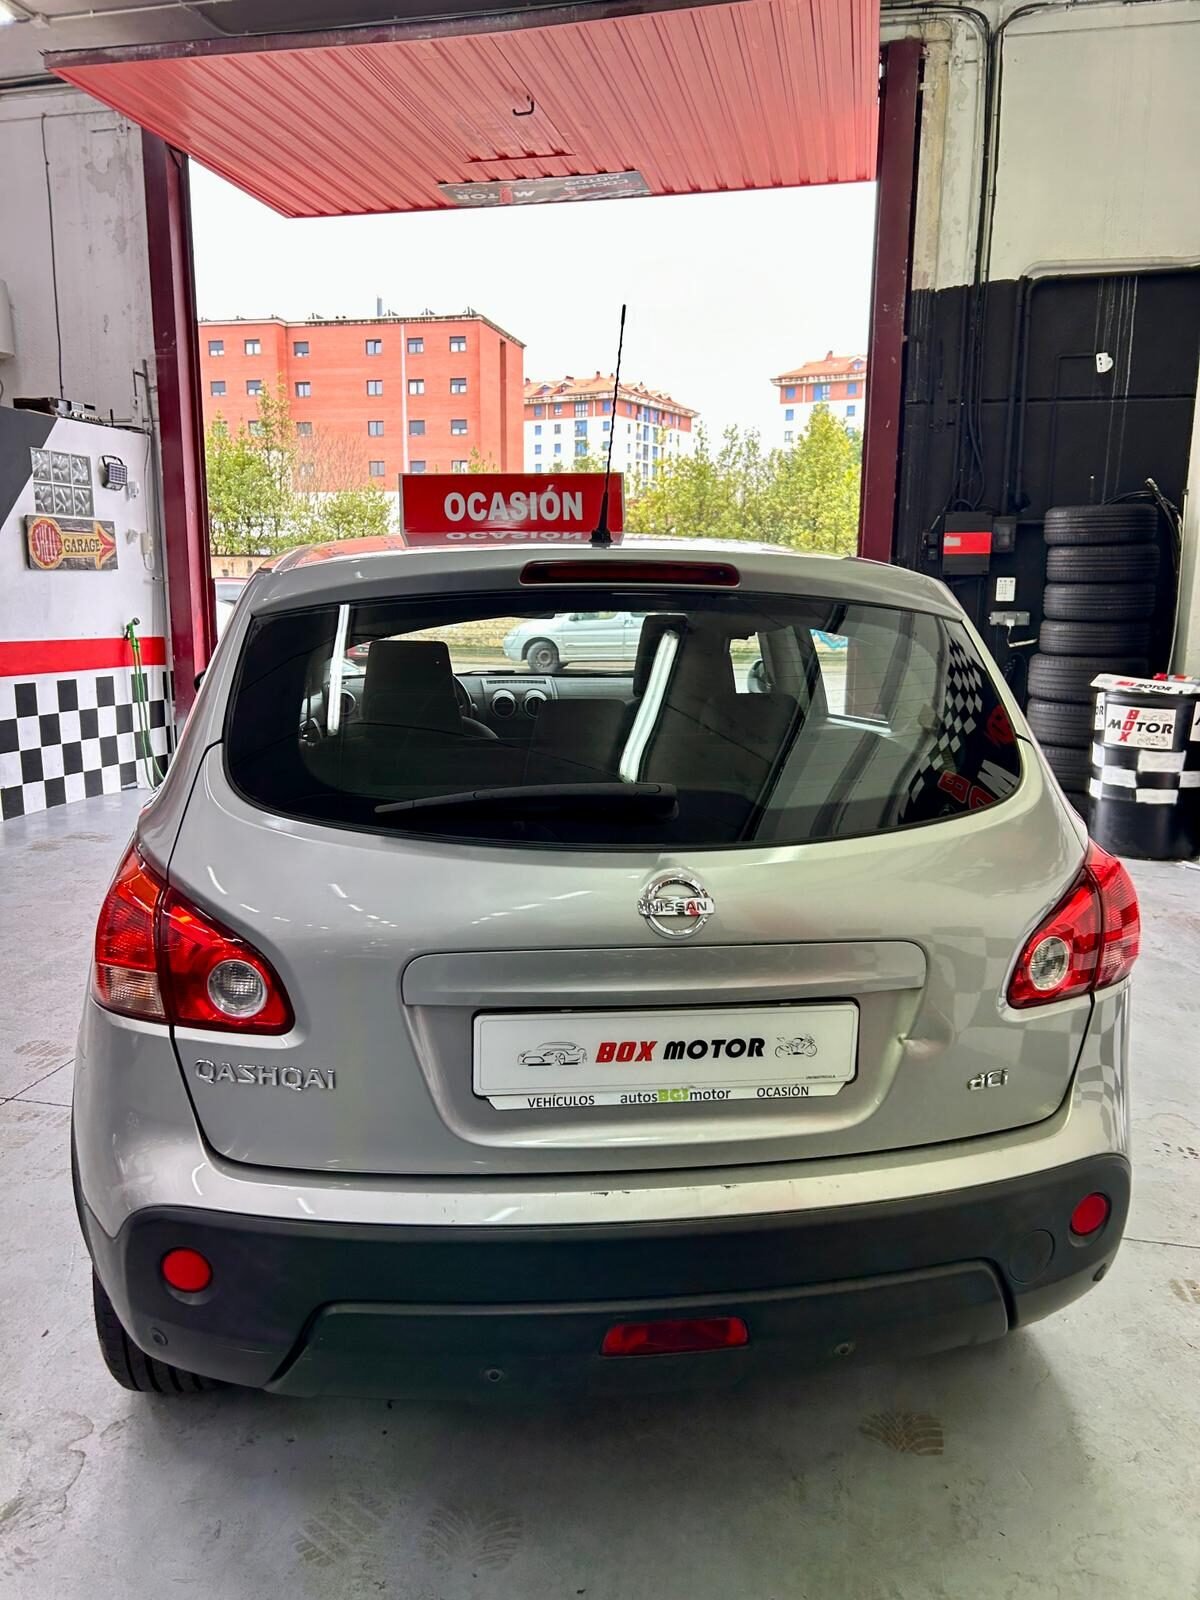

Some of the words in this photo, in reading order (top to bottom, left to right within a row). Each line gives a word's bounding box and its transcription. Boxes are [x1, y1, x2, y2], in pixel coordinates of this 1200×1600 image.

[444, 484, 583, 521] OCASIÓN
[63, 538, 100, 553] GARAGE
[647, 901, 708, 913] NISSAN
[595, 1041, 657, 1063] BOX
[663, 1038, 766, 1060] MOTOR
[527, 1093, 595, 1107] VEHÍCULOS
[756, 1084, 809, 1098] OCASIÓN
